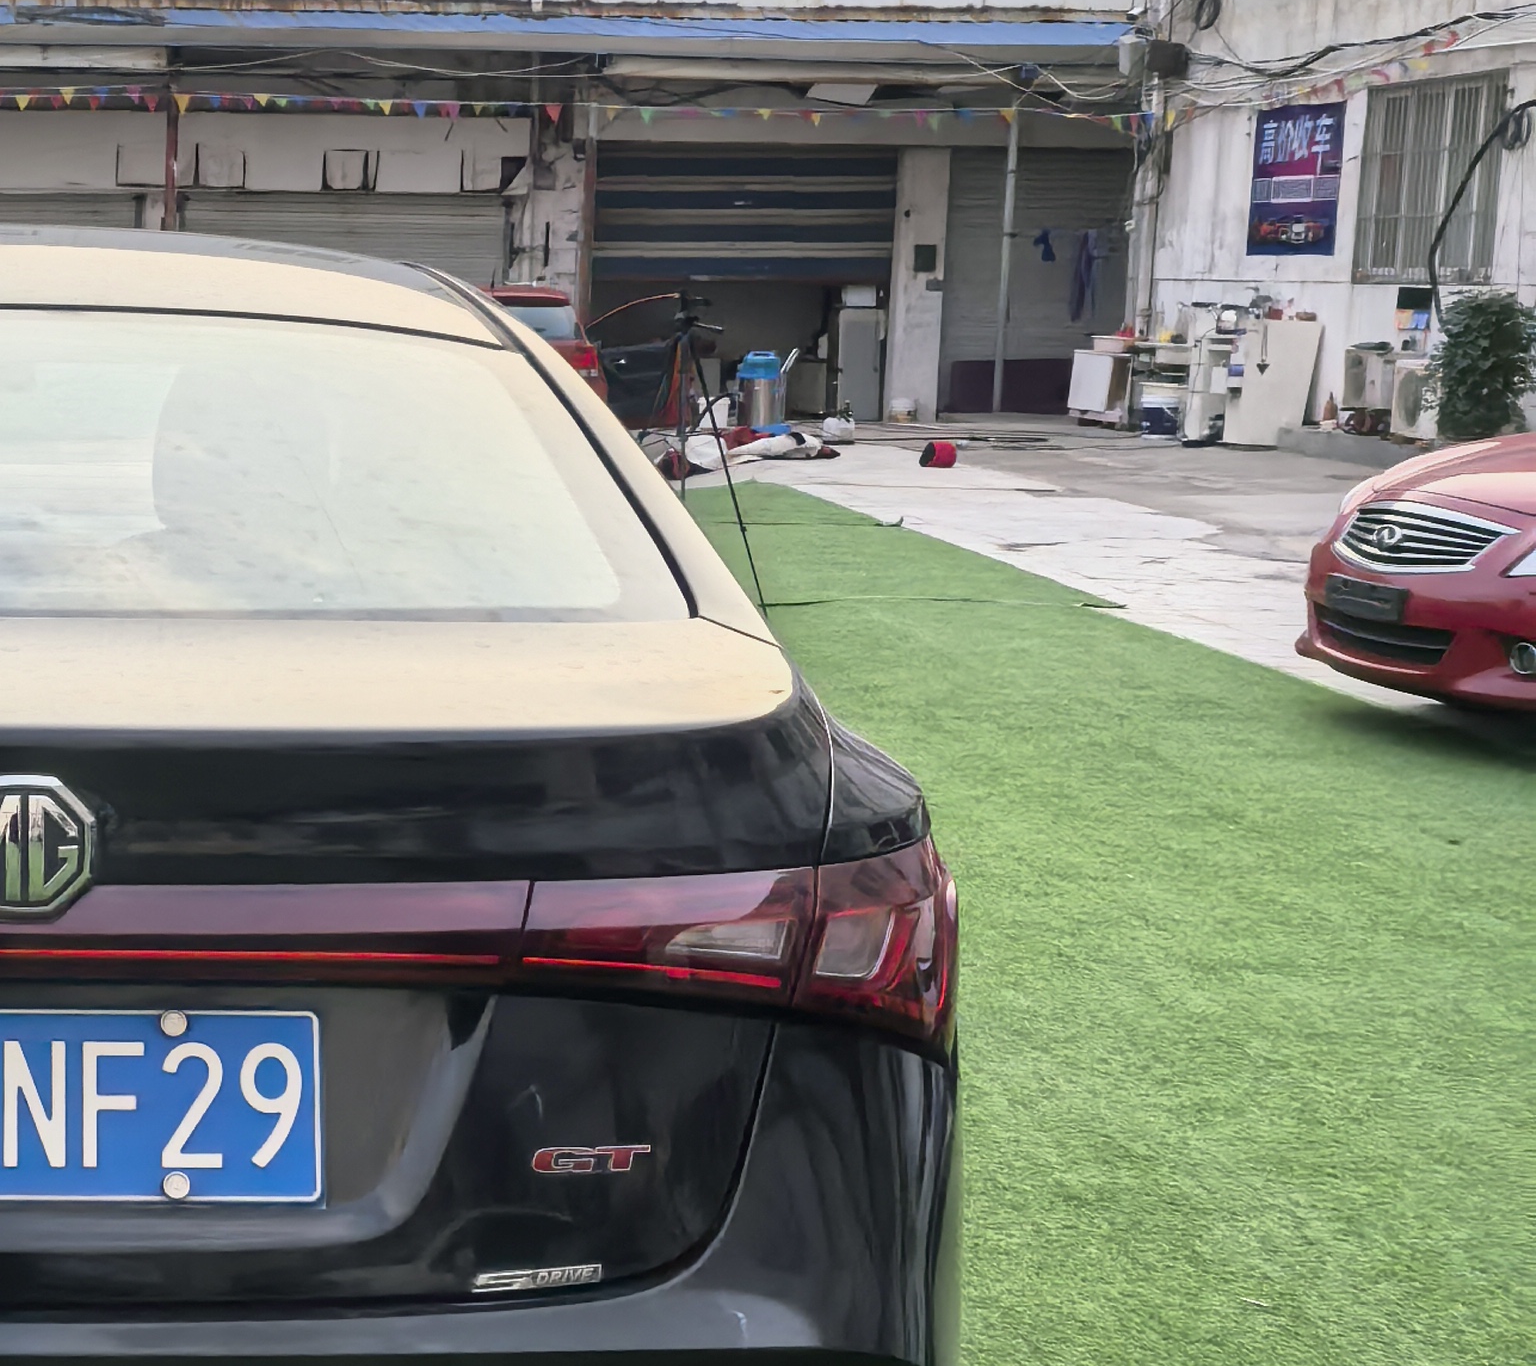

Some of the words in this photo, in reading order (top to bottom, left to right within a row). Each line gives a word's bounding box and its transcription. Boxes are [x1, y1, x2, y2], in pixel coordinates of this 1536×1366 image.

[1259, 113, 1334, 176] 高价收车
[532, 1145, 651, 1173] GT
